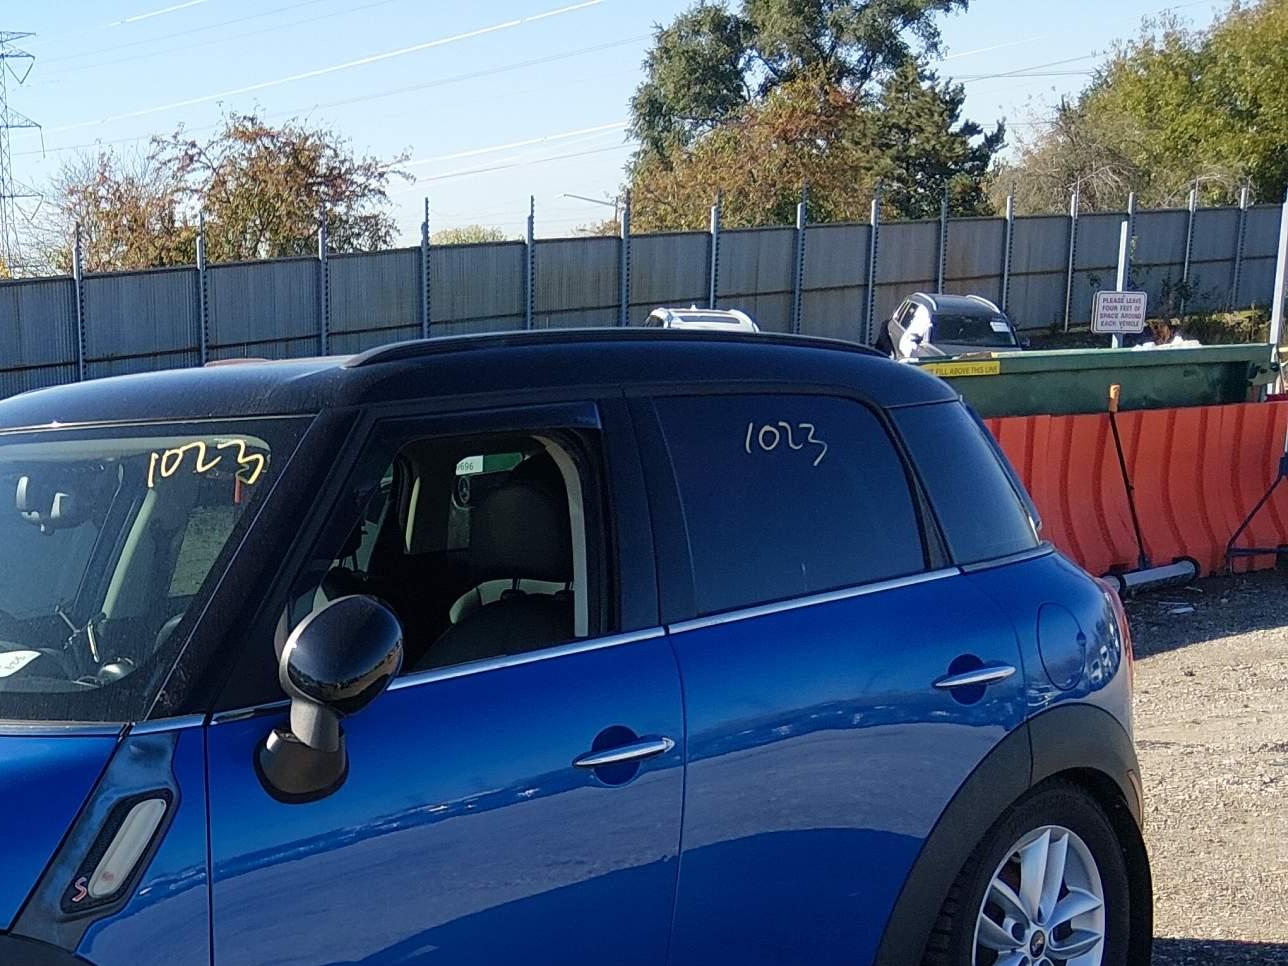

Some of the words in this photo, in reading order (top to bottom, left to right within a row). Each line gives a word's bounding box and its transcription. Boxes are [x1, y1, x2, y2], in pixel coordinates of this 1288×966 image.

[949, 367, 971, 375] ABOVE
[745, 421, 828, 467] 1023
[147, 439, 265, 488] 1023
[71, 877, 89, 903] S
